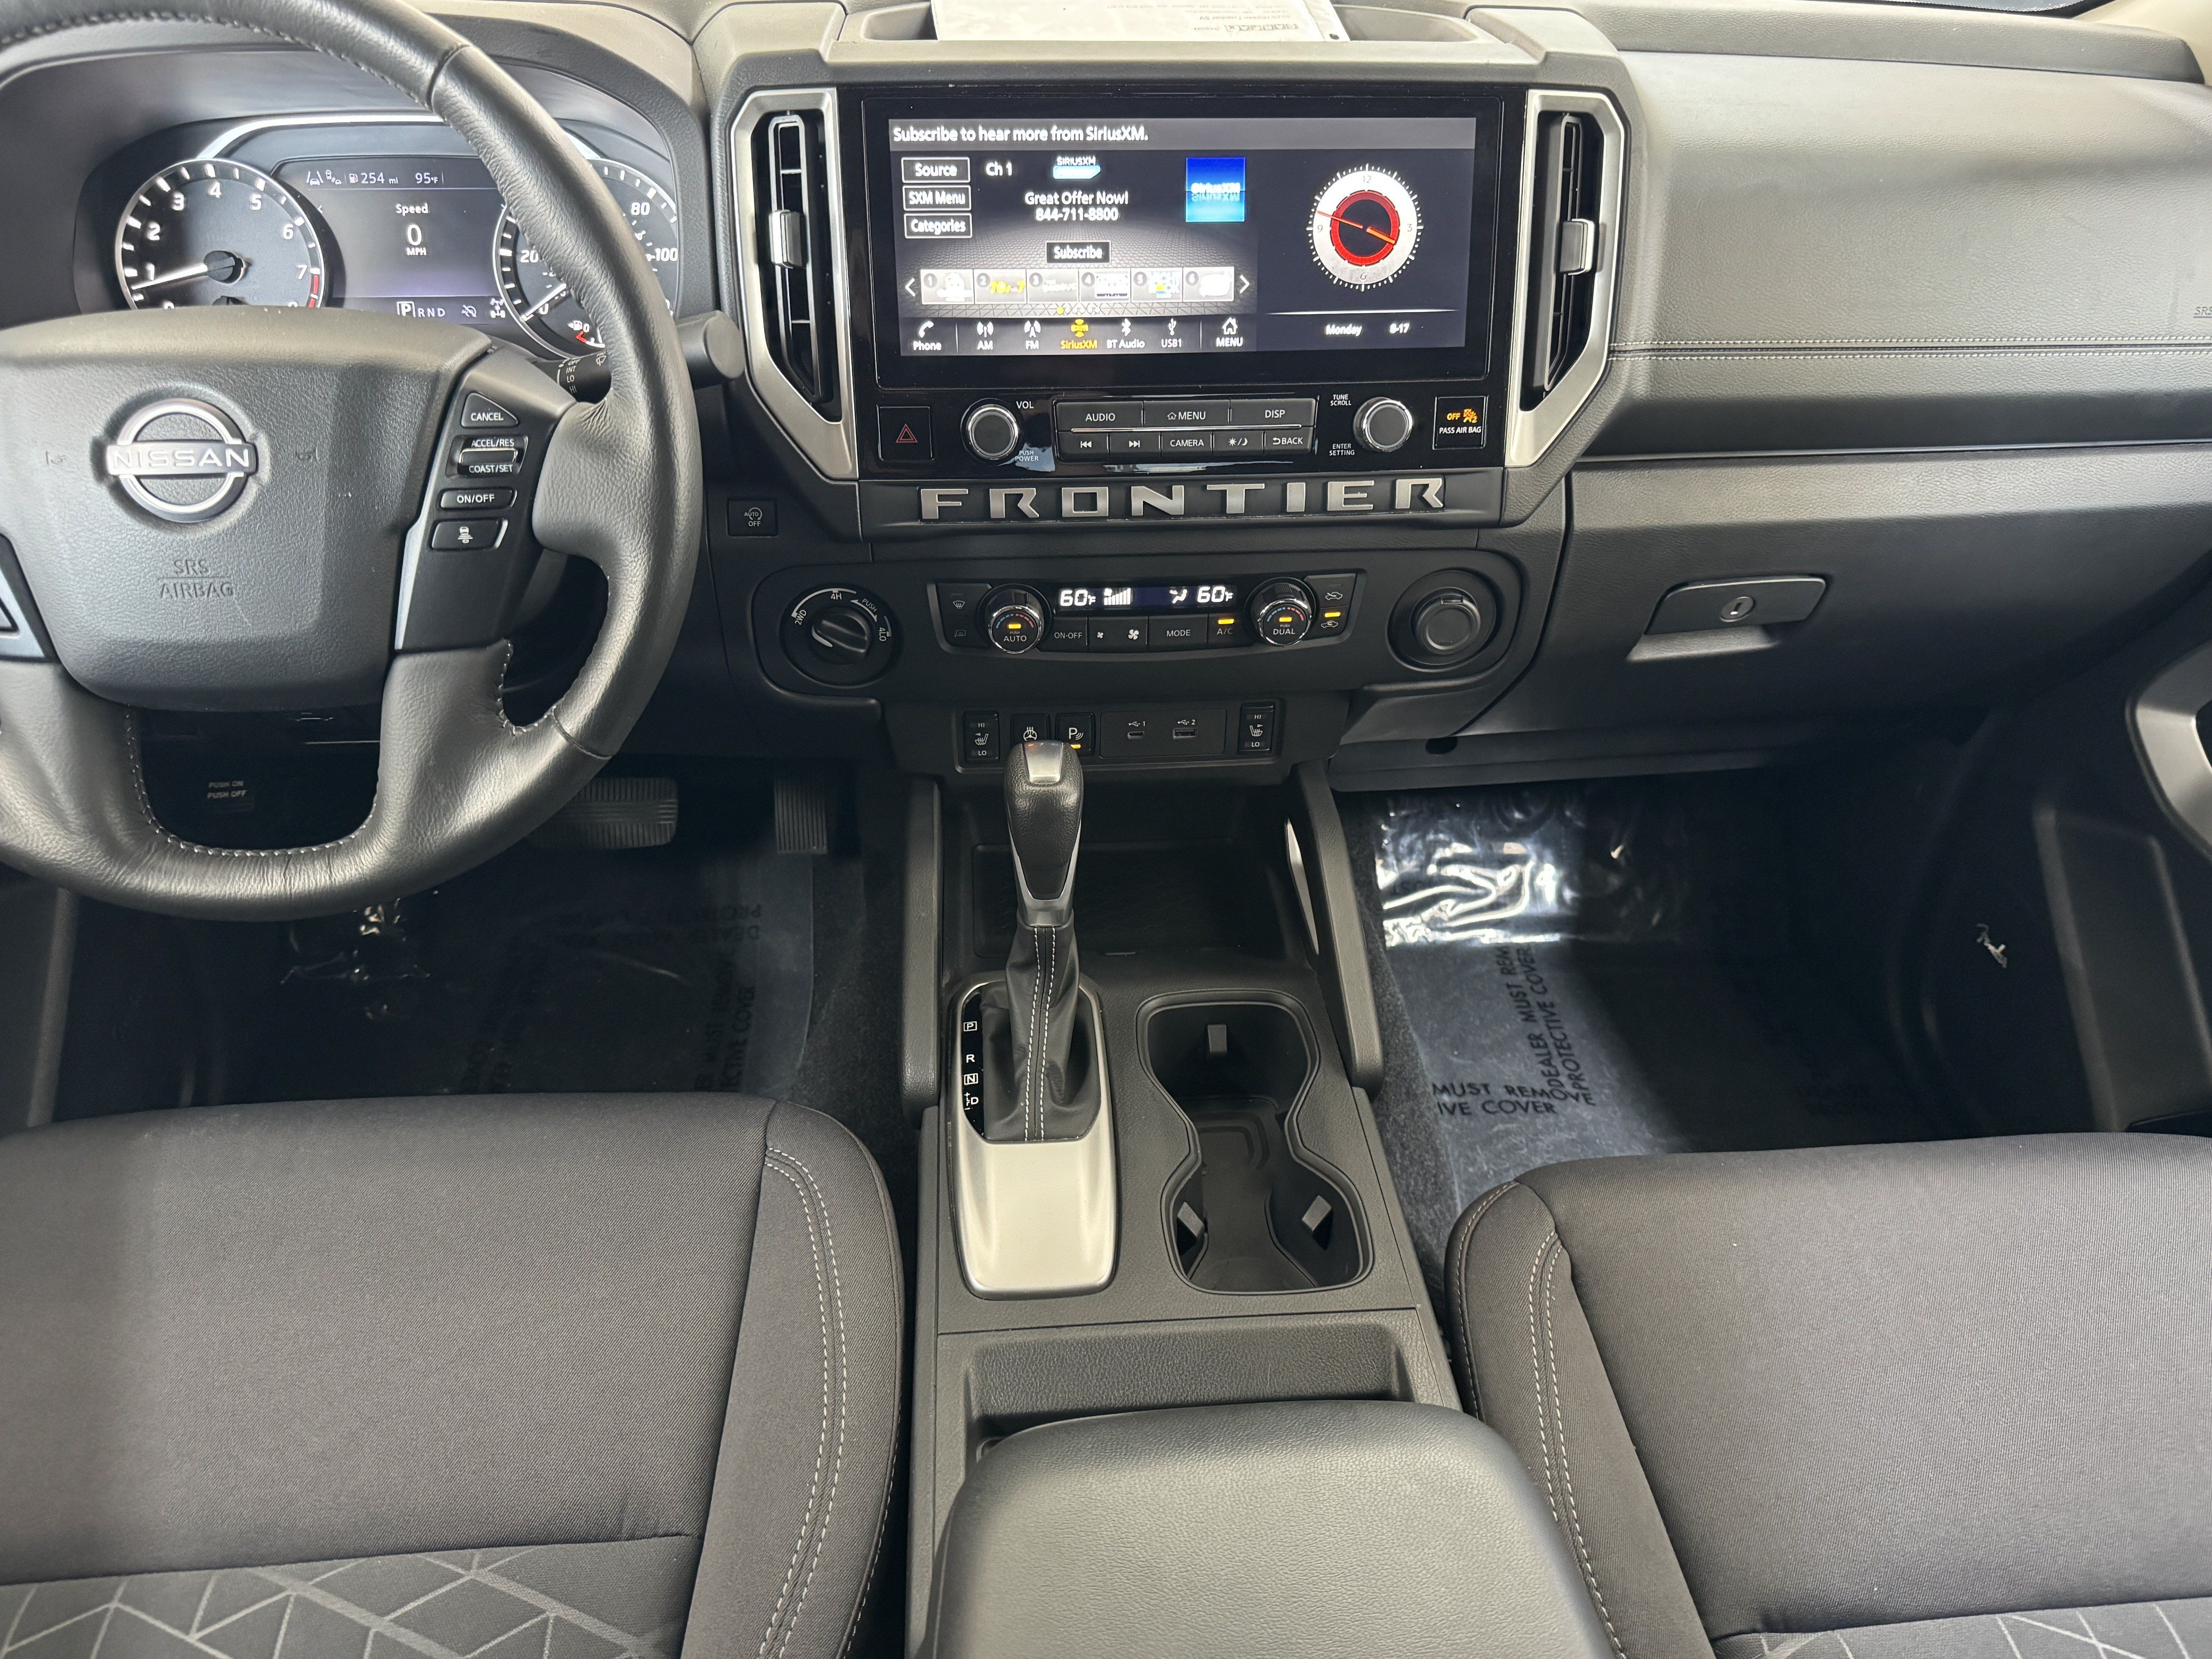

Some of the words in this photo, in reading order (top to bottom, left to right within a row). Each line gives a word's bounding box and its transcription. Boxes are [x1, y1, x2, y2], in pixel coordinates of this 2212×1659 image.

[893, 127, 958, 142] Subscribe
[960, 128, 975, 141] to
[978, 127, 1010, 141] hear
[1013, 129, 1048, 141] more
[1051, 126, 1084, 141] from
[915, 163, 958, 178] Source
[986, 161, 1004, 176] Ch
[1006, 162, 1013, 175] 1
[361, 172, 385, 184] 254
[1363, 175, 1371, 184] 12
[210, 183, 221, 198] 4
[172, 196, 185, 211] 3
[251, 195, 262, 211] 5
[909, 192, 934, 206] SXM
[936, 191, 966, 205] Menu
[1025, 192, 1059, 206] Great
[1061, 191, 1093, 205] Offer
[1096, 191, 1128, 205] Now!
[395, 203, 429, 216] Speed
[630, 202, 650, 215] 80
[1036, 208, 1119, 221] 844-711-8800
[147, 224, 160, 240] 2
[282, 223, 294, 240] 6
[910, 219, 966, 235] Categories
[1407, 223, 1412, 232] 3
[406, 224, 422, 246] 0
[406, 247, 427, 256] MPH
[520, 249, 538, 263] 20
[655, 247, 678, 262] 100
[1054, 247, 1103, 260] Subscribe
[146, 263, 155, 280] 1
[297, 265, 308, 280] 7
[401, 303, 411, 316] P
[417, 308, 425, 317] R
[427, 308, 435, 317] N
[437, 308, 445, 317] D
[1326, 323, 1362, 337] Monday
[913, 340, 942, 352] Phone
[977, 340, 994, 351] AM
[1025, 340, 1039, 350] FM
[1061, 340, 1097, 349] SiriusXM
[1107, 339, 1117, 349] BT
[1119, 338, 1145, 349] Audio
[1161, 338, 1183, 349] USB1
[1216, 337, 1243, 347] MENU
[566, 365, 577, 374] INT
[567, 374, 575, 383] LO
[1016, 401, 1034, 409] VOL
[471, 412, 504, 421] CANCEL
[1085, 413, 1116, 422] AUDIO
[1178, 410, 1206, 420] MENU
[1265, 409, 1286, 419] DISP
[471, 438, 515, 447] ACCEL/RES
[1170, 439, 1204, 447] CAMERA
[1281, 437, 1304, 446] BACK
[113, 448, 250, 468] NISSAN
[469, 464, 514, 473] COAST/SET
[457, 494, 495, 503] ON/OFF
[921, 477, 1444, 519] FRONTIER
[173, 559, 209, 575] SRS
[159, 582, 235, 599] AIRBAG
[862, 598, 878, 613] PUSH
[795, 609, 807, 625] 2WD
[1166, 629, 1191, 637] MODE
[1216, 627, 1233, 635] A/C
[1516, 945, 1548, 995] COVER
[1506, 982, 1537, 1023] MUST
[1536, 1001, 1590, 1091] PROTECTIVE
[966, 1054, 975, 1063] R
[1527, 1033, 1564, 1087] DEALER
[967, 1074, 976, 1083] N
[970, 1096, 979, 1105] D
[1432, 1082, 1491, 1097] MUST
[1504, 1085, 1596, 1106] REMOVE
[1482, 1099, 1557, 1115] COVER
